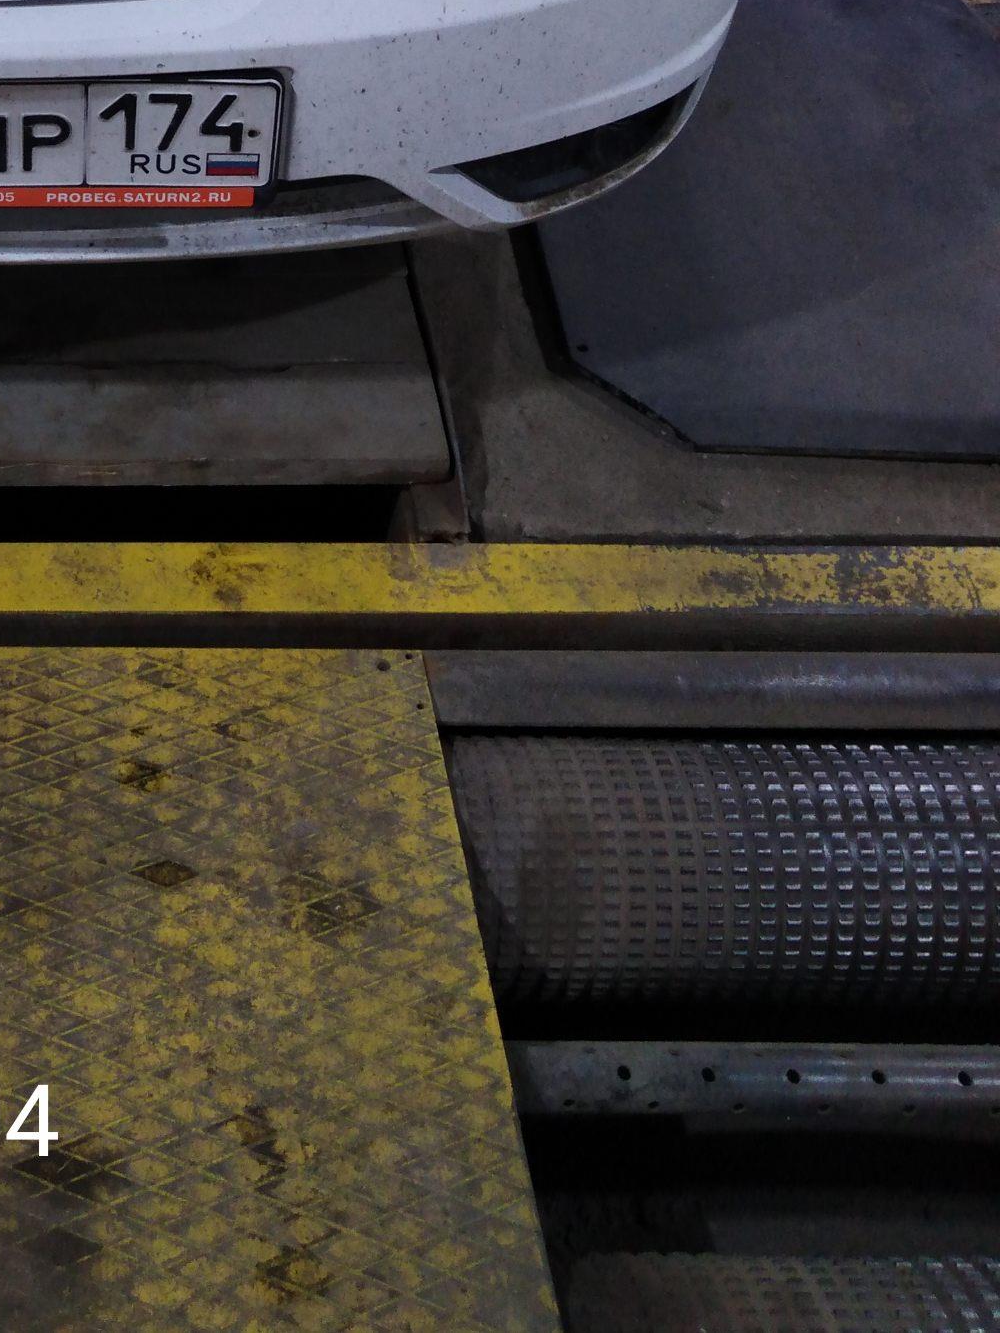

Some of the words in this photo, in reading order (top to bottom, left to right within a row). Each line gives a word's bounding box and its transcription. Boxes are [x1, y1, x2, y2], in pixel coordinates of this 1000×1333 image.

[98, 93, 244, 152] 174
[129, 153, 201, 175] RUS
[46, 191, 232, 204] PROBEG.SATURN2.RU
